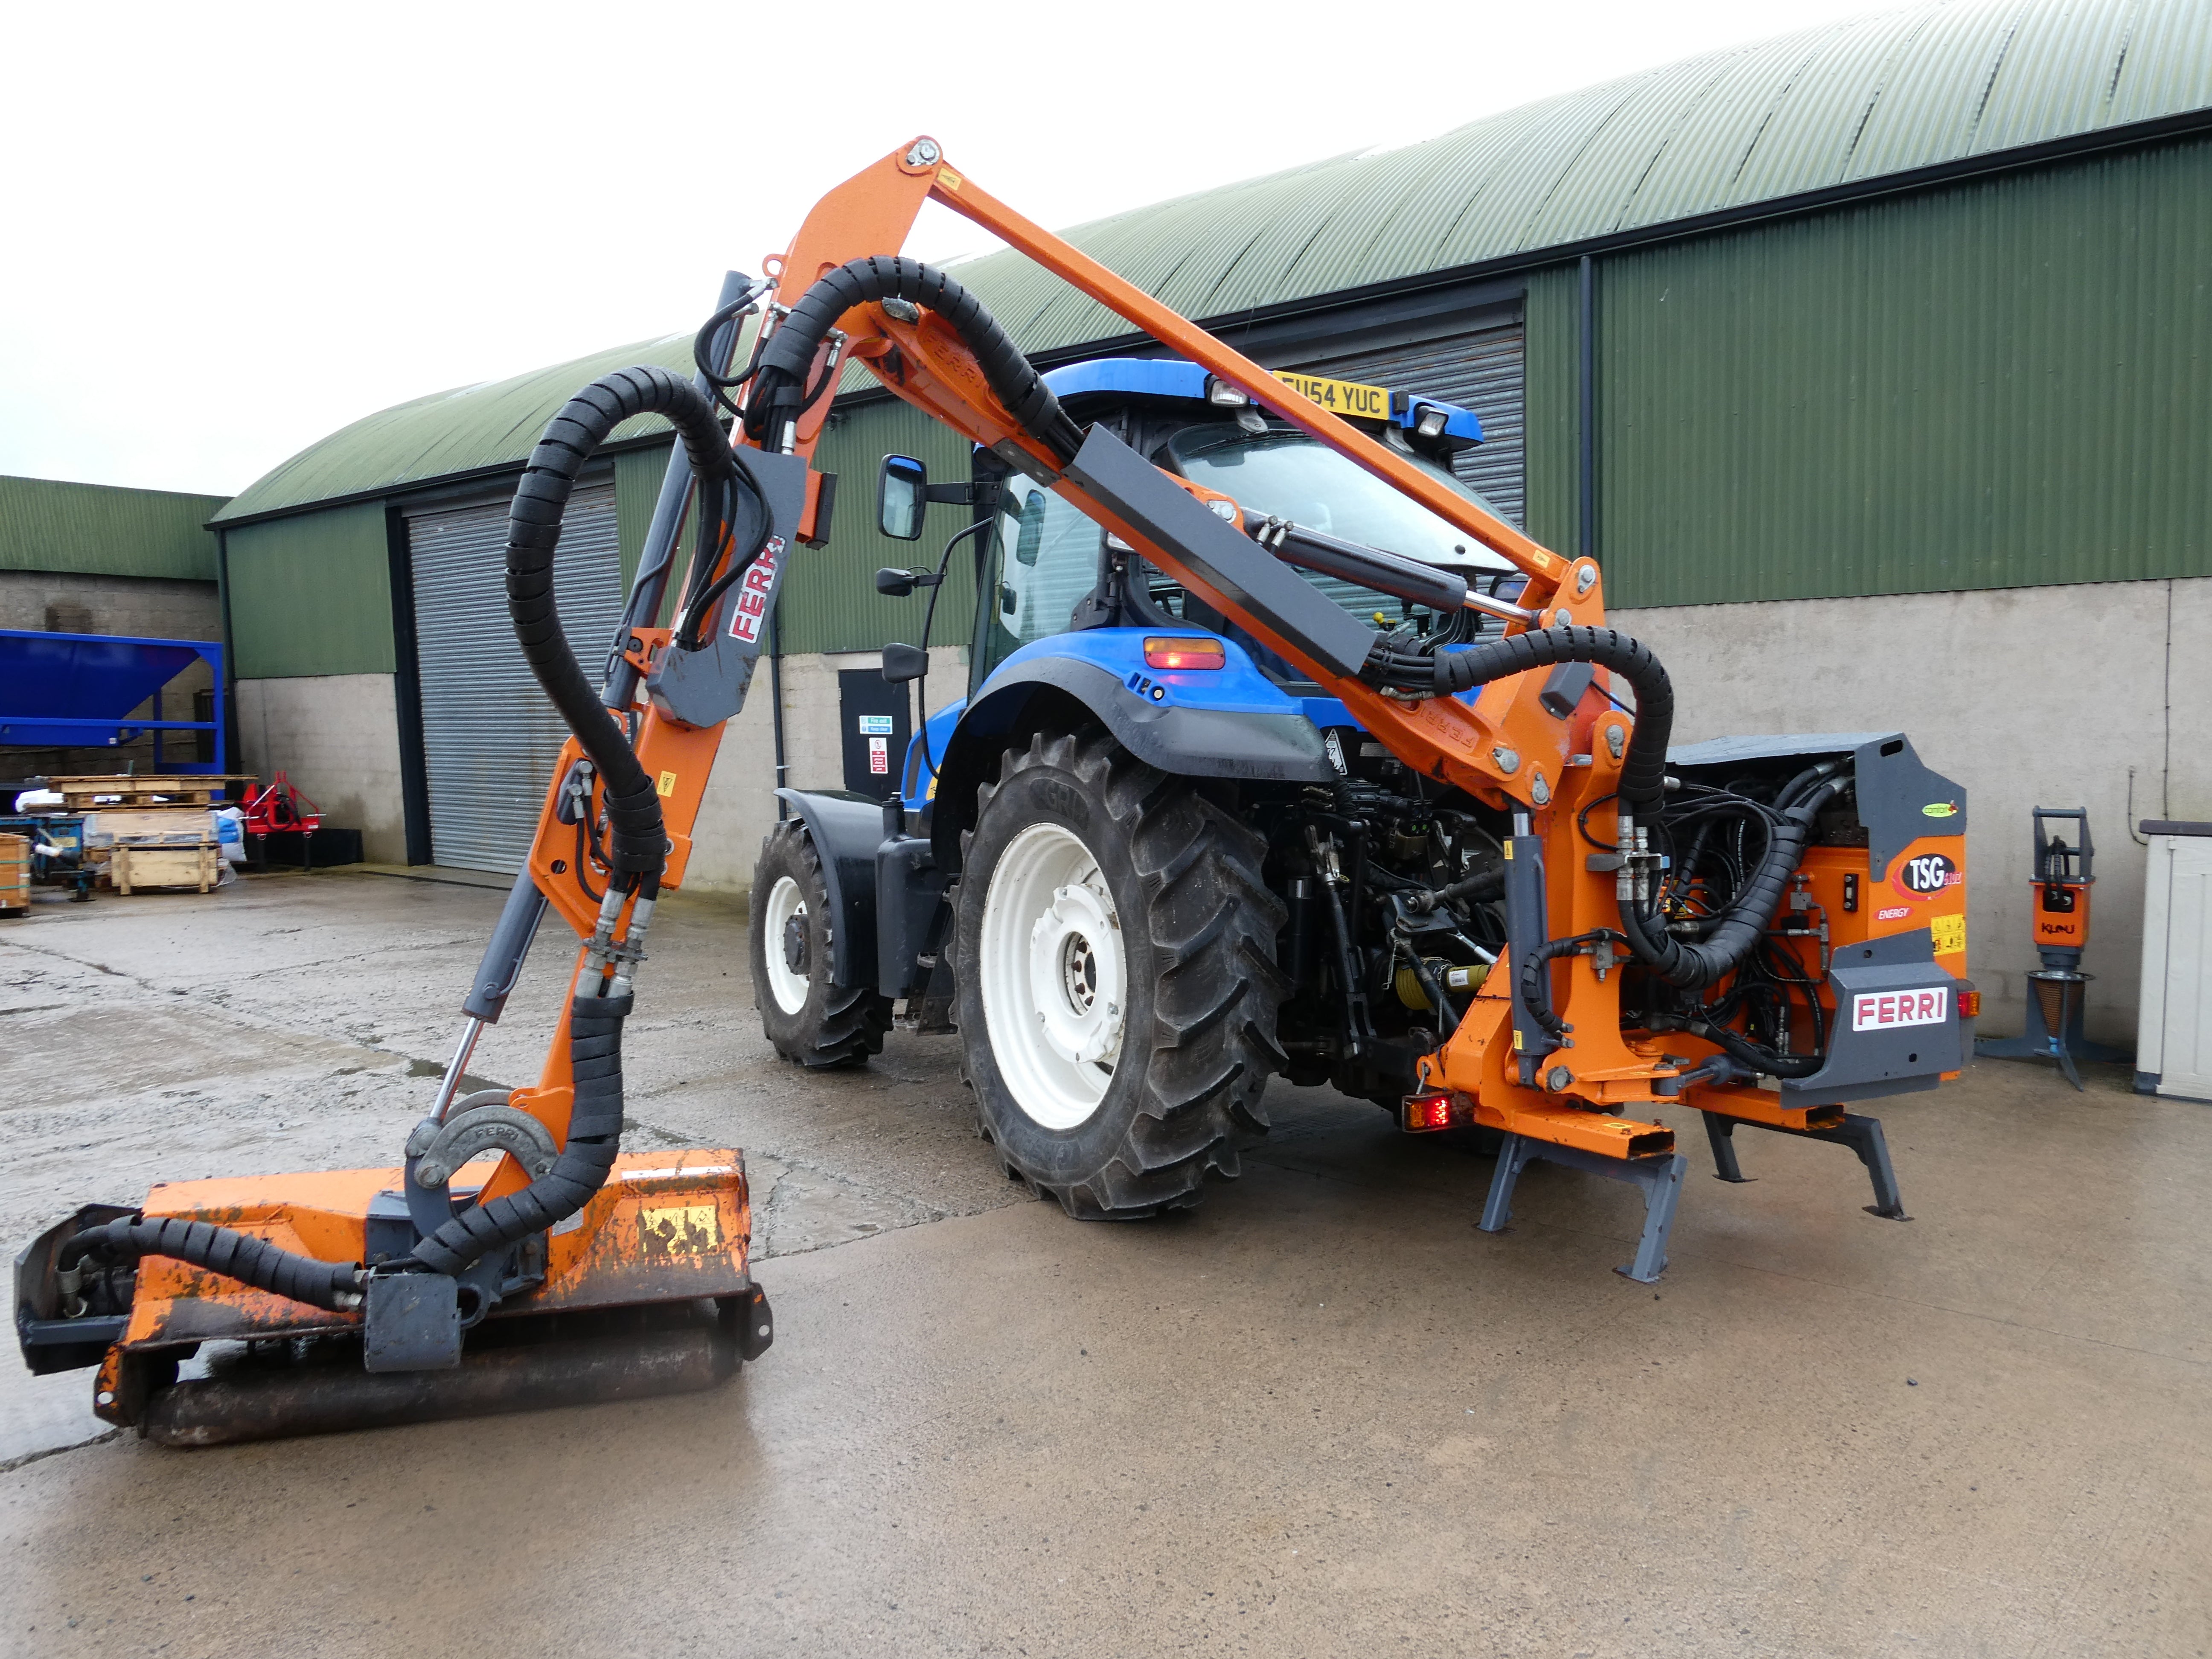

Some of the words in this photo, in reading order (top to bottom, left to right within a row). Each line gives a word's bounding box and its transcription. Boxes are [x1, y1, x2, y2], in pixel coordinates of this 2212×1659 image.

[1343, 386, 1380, 413] YUC
[1909, 857, 1945, 889] TSG
[1878, 908, 1910, 920] ENERGY
[1857, 991, 1944, 1026] FERRI
